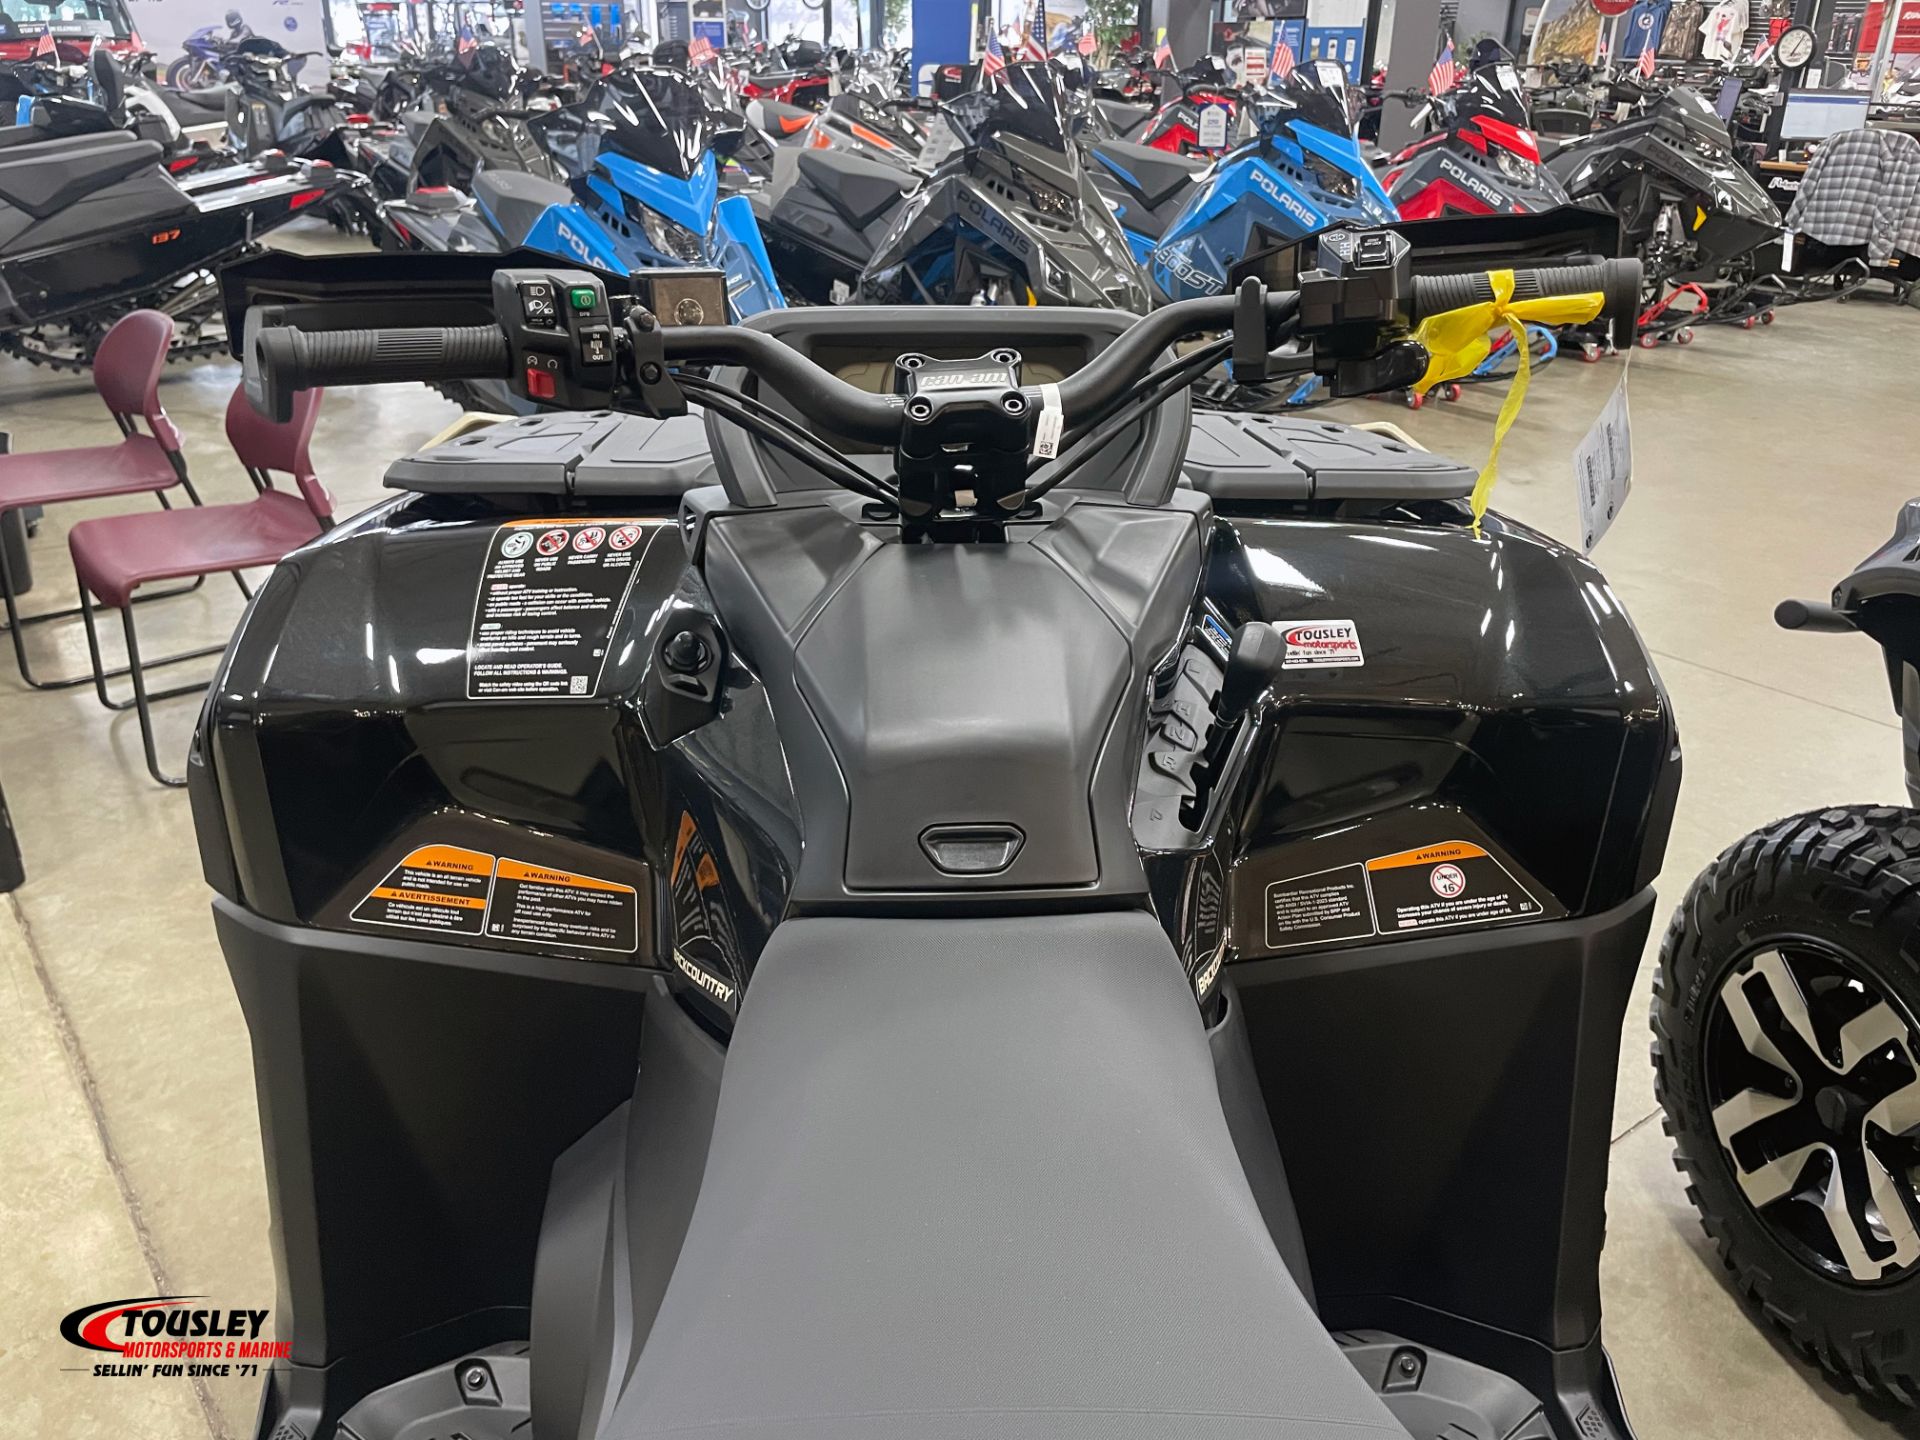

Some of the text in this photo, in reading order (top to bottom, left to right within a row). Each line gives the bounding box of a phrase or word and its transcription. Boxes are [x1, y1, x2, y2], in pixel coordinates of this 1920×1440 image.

[1440, 158, 1504, 207] POLARIS
[1249, 168, 1318, 227] POLARIS
[957, 189, 1032, 256] POLARIS
[558, 222, 612, 272] POLA
[920, 372, 1008, 387] can-am
[1296, 628, 1352, 640] TOUSLEY
[1303, 640, 1357, 650] motorsports
[1423, 849, 1461, 859] WARNING
[433, 861, 474, 871] WARNING
[531, 871, 570, 883] WARNING
[1442, 884, 1455, 893] 16
[399, 892, 471, 905] AVERTISSEMENT
